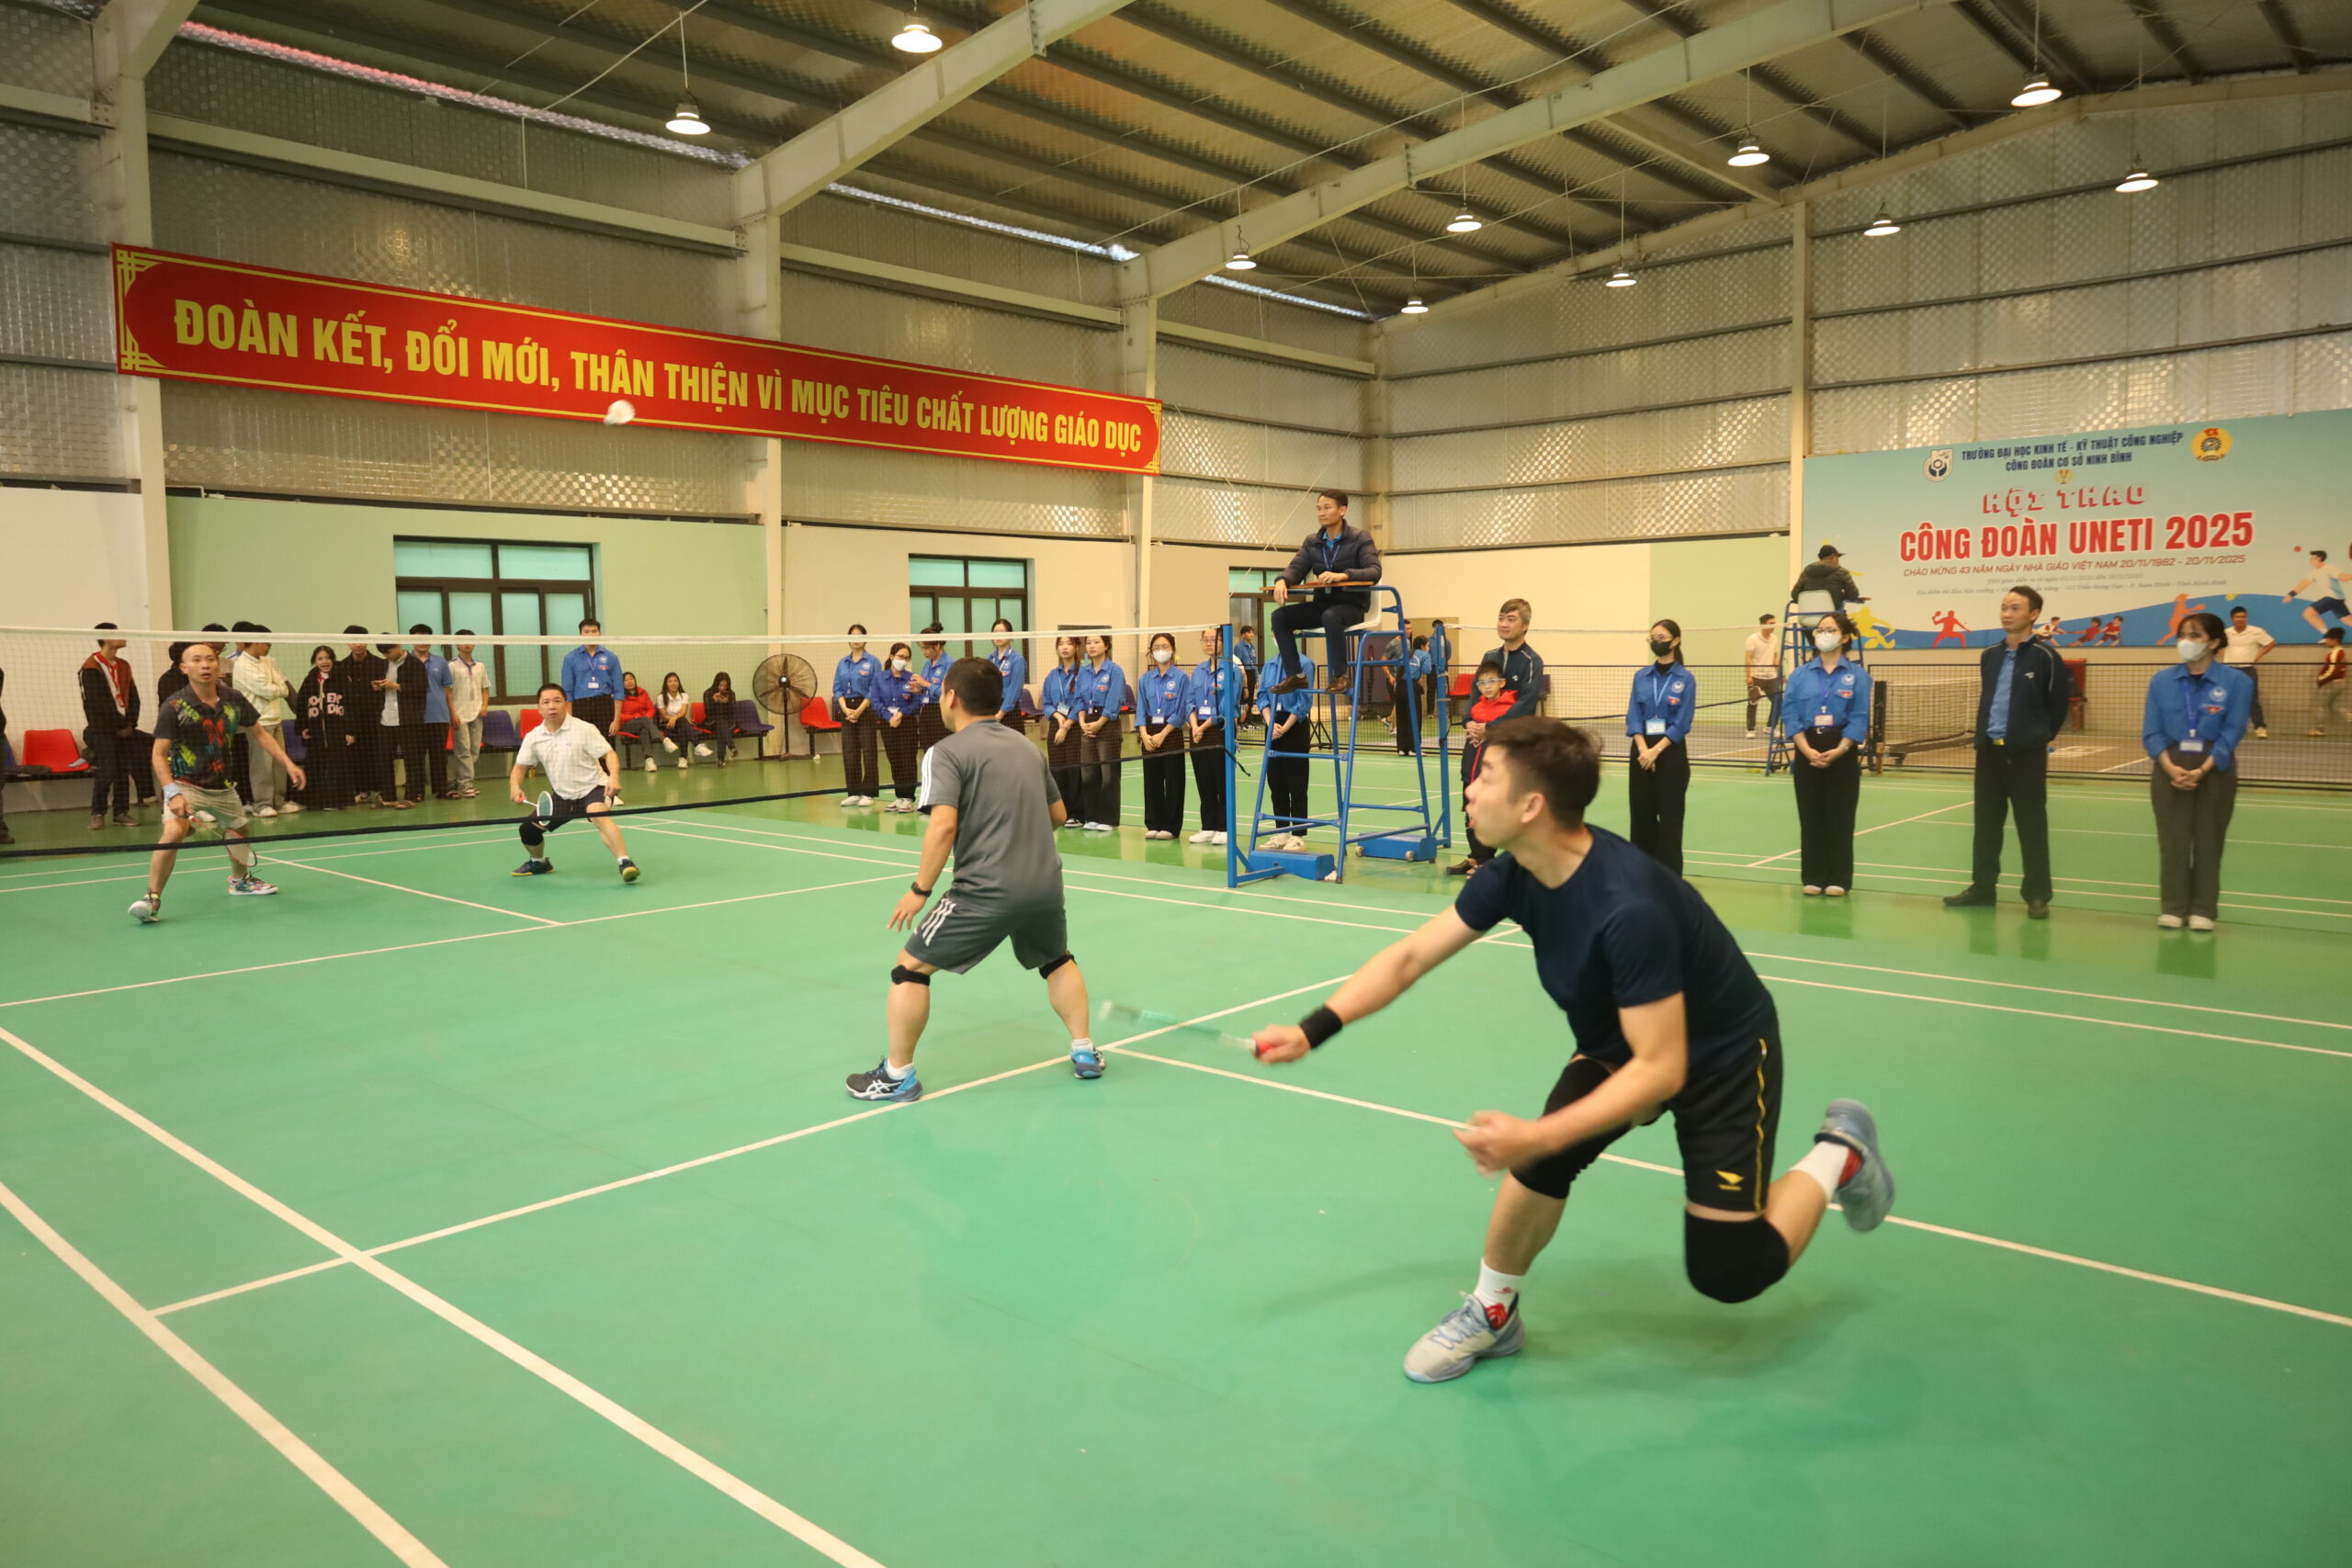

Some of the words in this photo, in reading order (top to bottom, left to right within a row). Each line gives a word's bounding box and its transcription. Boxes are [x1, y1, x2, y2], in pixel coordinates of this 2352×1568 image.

[174, 299, 299, 358] ĐOÀN
[312, 310, 393, 374] KẾT,
[404, 319, 469, 378] ĐỔI
[481, 336, 560, 392] MỚI,
[570, 349, 655, 398] THÂN
[663, 362, 748, 413] THIỆN
[756, 369, 782, 411] VÌ
[791, 378, 849, 424] MỤC
[857, 385, 909, 426] TIÊU
[916, 390, 975, 434] CHẤT
[980, 404, 1049, 446] LƯỢNG
[1054, 411, 1100, 448] GIÁO
[1104, 420, 1142, 457] DỤC
[1962, 446, 1995, 461] TRƯỜNG
[1997, 447, 2011, 460] ĐẠI
[2014, 446, 2031, 458] HỌC
[2033, 443, 2054, 456] KINH
[2057, 439, 2068, 453] TẾ
[2076, 439, 2087, 451] KỸ
[2091, 436, 2118, 451] THUẬT
[2121, 433, 2146, 447] CÔNG
[2149, 430, 2183, 446] NGHIỆP
[2006, 457, 2028, 472] CÔNG
[2030, 456, 2054, 470] ĐOÀN
[2057, 455, 2068, 468] CƠ
[2072, 452, 2084, 467] SỞ
[2086, 453, 2108, 466] NINH
[2110, 450, 2132, 464] BÌNH
[1900, 522, 1971, 562] CÔNG
[1981, 517, 2058, 558] ĐOÀN
[2069, 517, 2154, 555] UNETI
[2165, 512, 2254, 550] 2025
[1904, 567, 1928, 577] CHÀO
[1930, 565, 1957, 576] MỪNG
[1959, 566, 1971, 575] 43
[1973, 563, 1994, 574] NĂM
[1996, 562, 2021, 573] NGÀY
[2023, 561, 2043, 571] NHÀ
[2046, 559, 2069, 571] GIÁO
[2072, 558, 2092, 571] VIỆT
[2095, 559, 2118, 569] NAM
